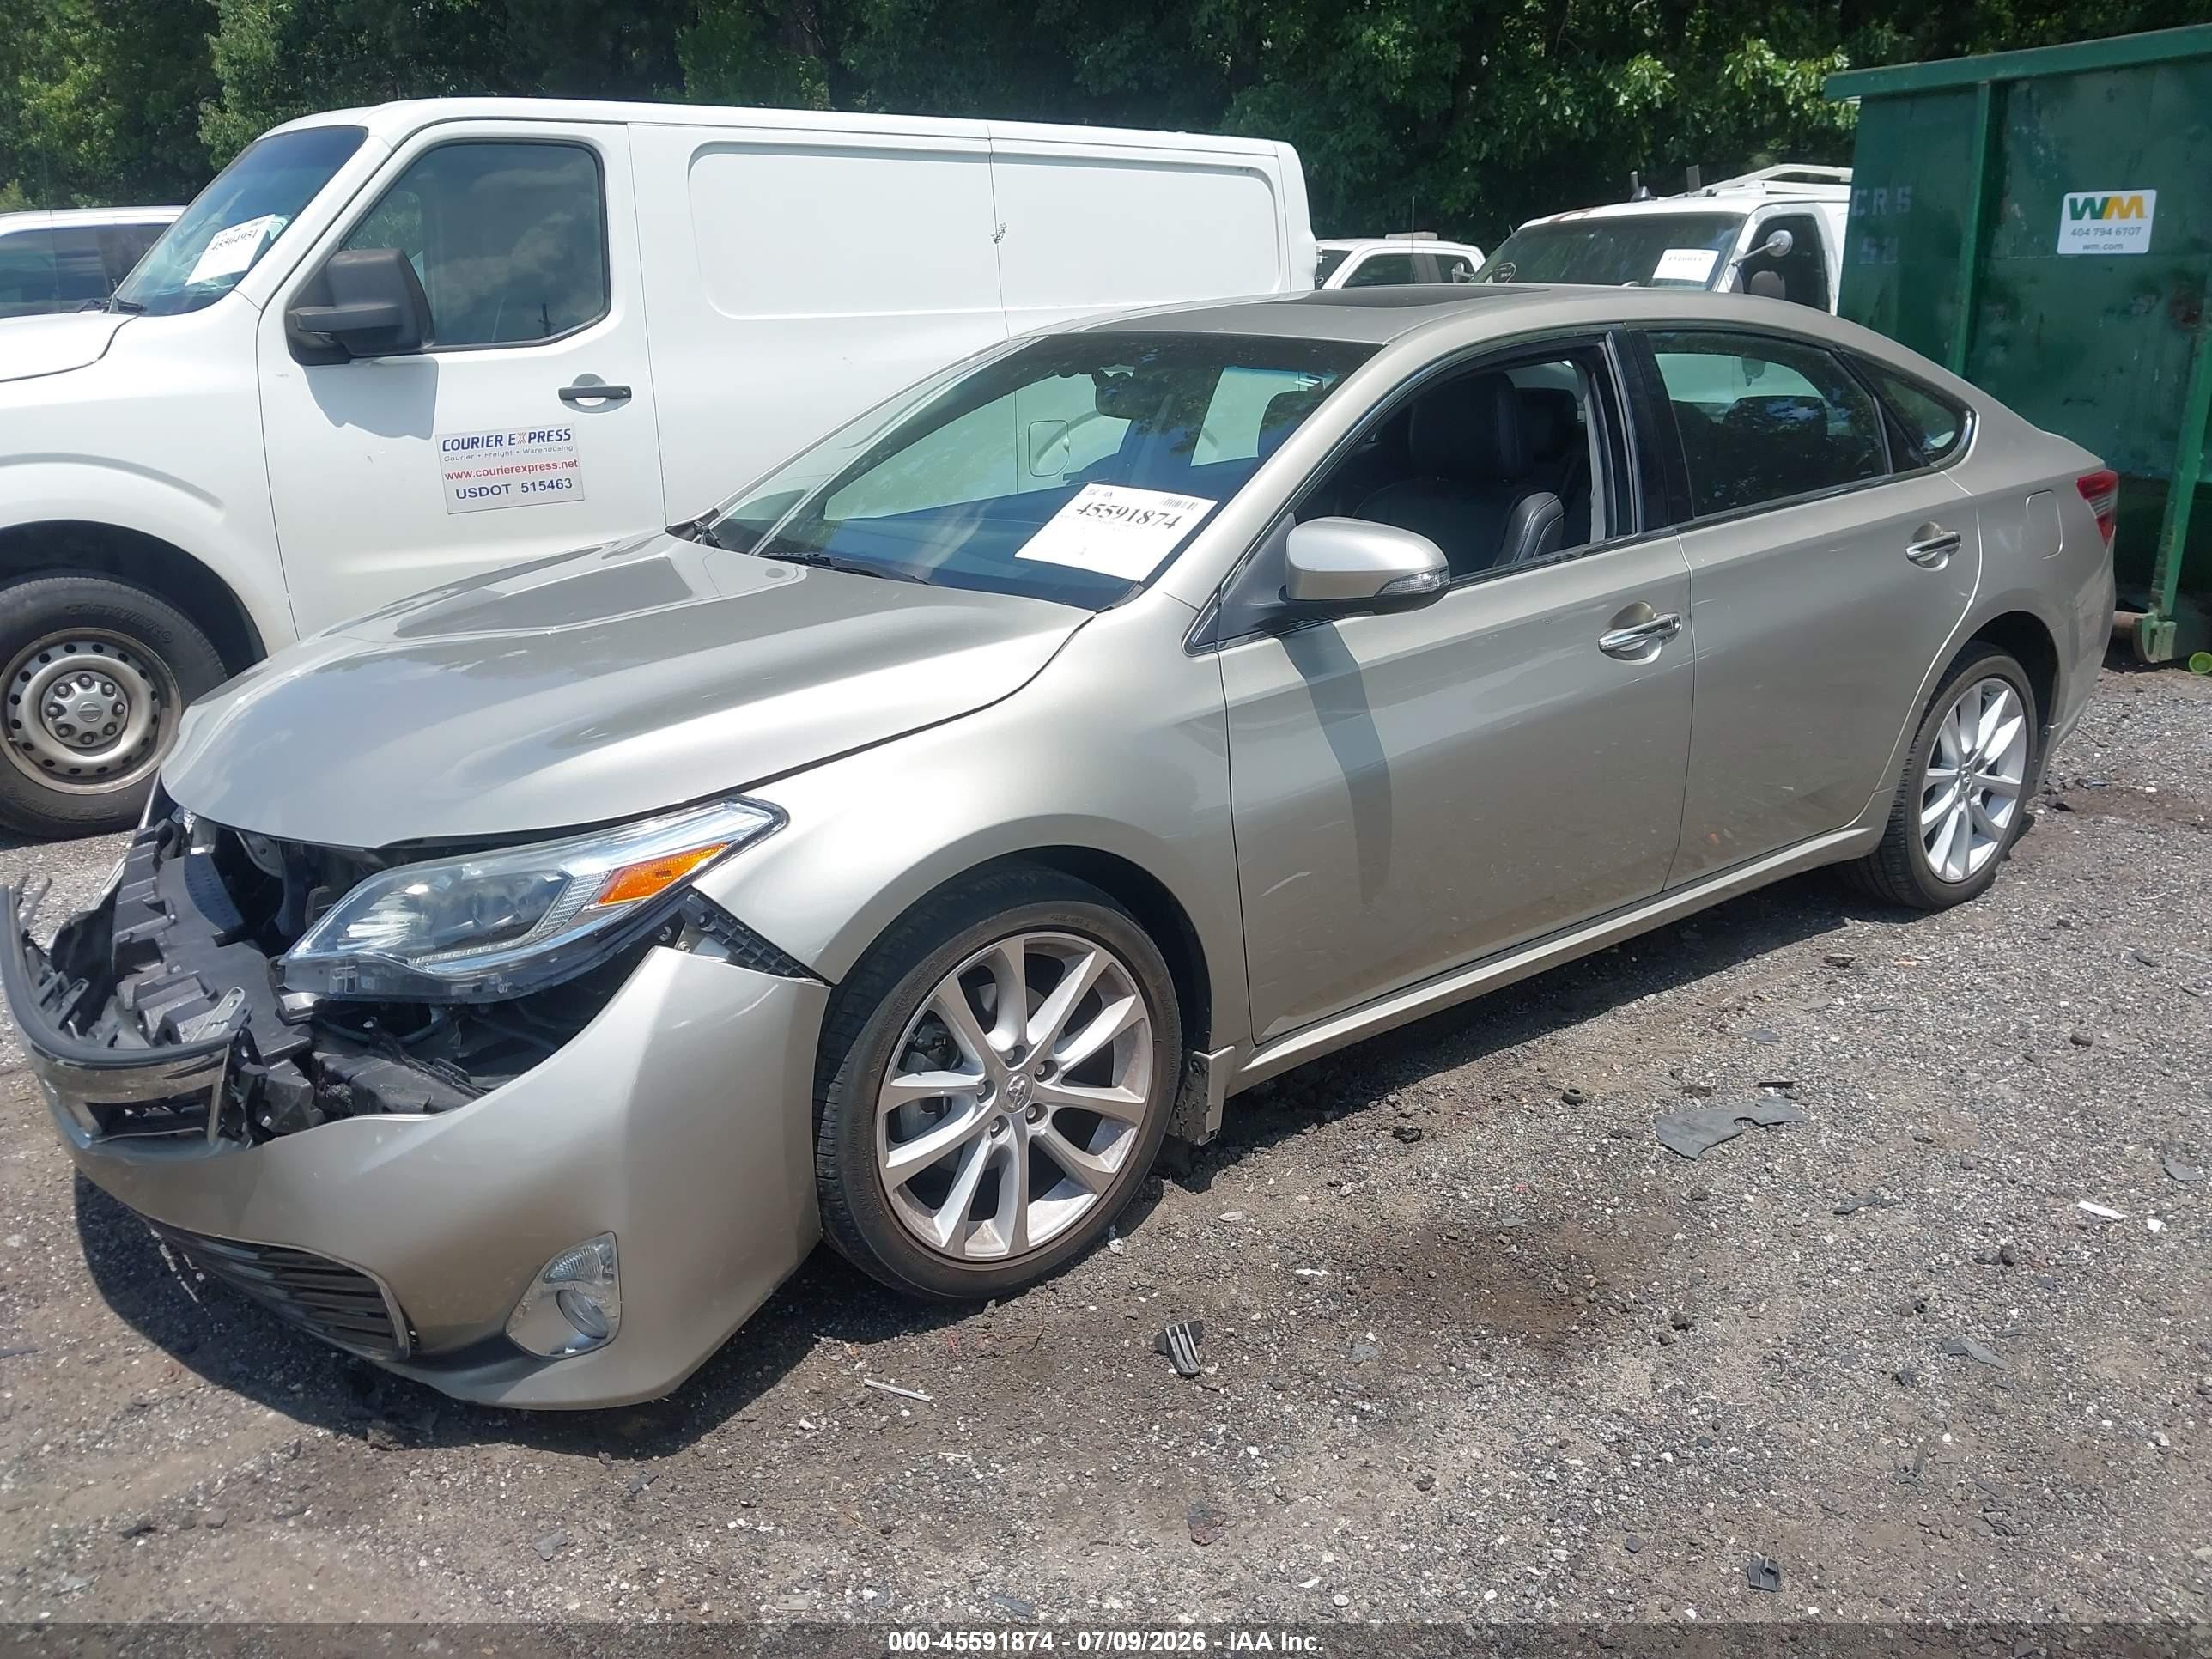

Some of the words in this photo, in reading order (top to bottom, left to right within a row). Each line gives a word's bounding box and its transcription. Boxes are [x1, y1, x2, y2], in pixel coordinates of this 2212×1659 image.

[2069, 195, 2144, 221] WM
[2070, 228, 2090, 237] 404
[2094, 227, 2112, 237] 794
[2115, 226, 2142, 236] 6707
[442, 434, 504, 452] COURIER
[507, 428, 572, 446] EXPRESS
[444, 453, 474, 462] Courier
[484, 450, 513, 459] Freight
[522, 445, 574, 455] Warehousing
[445, 459, 578, 481] www.courierexpress.net
[455, 483, 512, 500] USDOT
[520, 477, 573, 494] 515463
[1076, 501, 1182, 530] 45591874
